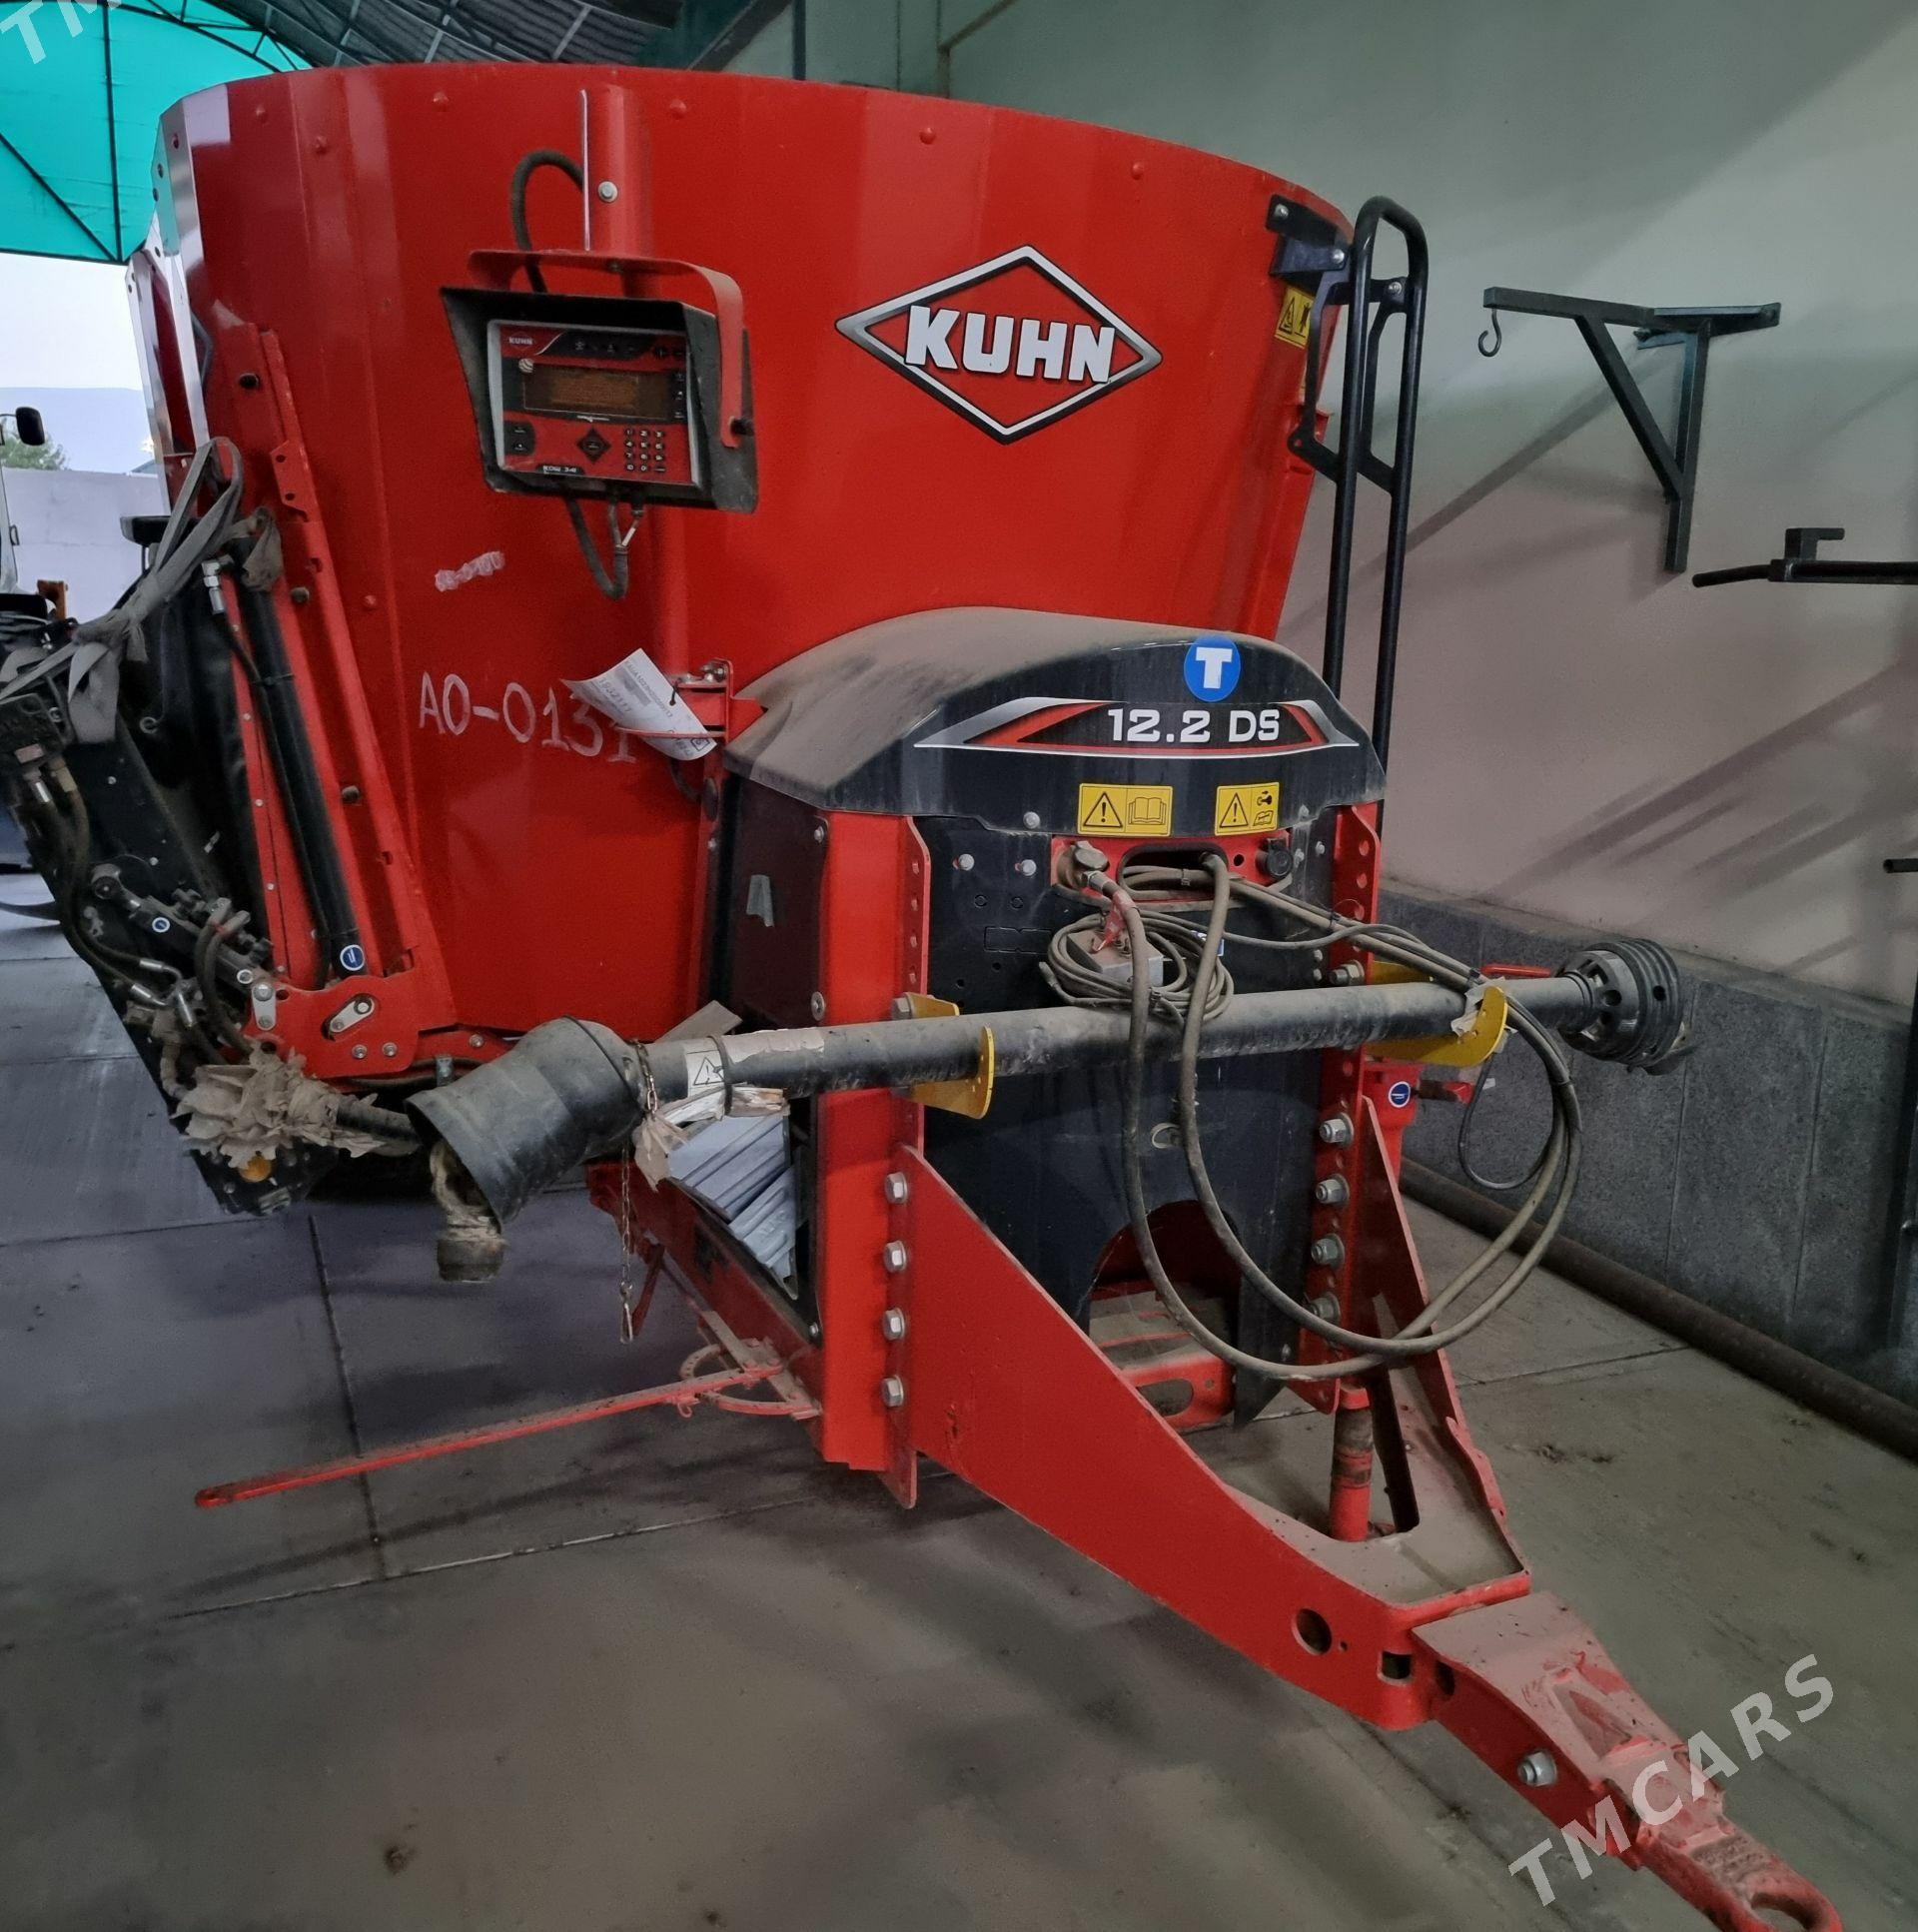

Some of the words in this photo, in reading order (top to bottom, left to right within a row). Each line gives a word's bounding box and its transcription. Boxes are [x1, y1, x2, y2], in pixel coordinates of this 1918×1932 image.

[508, 337, 533, 346] KUHN
[904, 305, 1116, 384] KUHN
[1195, 646, 1234, 689] T
[1107, 708, 1211, 743] 12.2
[1228, 708, 1281, 743] DS
